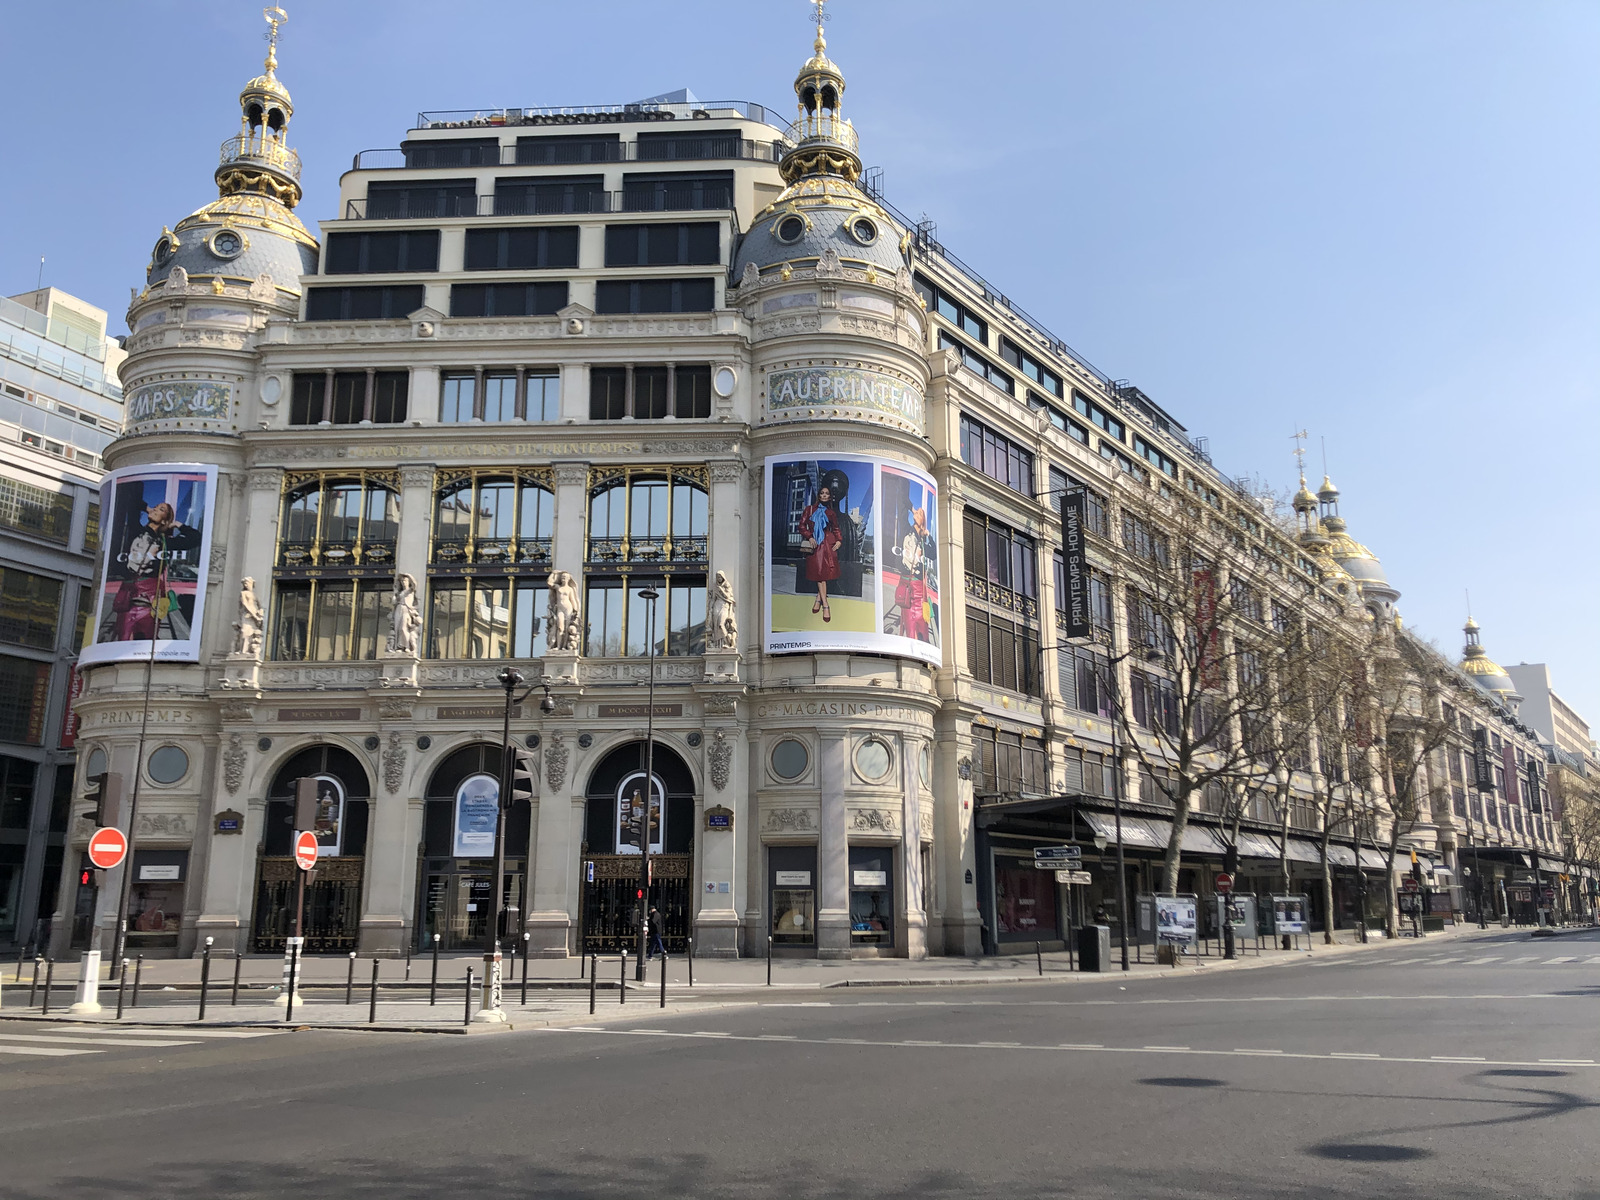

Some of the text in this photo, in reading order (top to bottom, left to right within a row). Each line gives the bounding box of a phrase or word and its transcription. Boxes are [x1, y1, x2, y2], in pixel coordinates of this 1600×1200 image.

[778, 377, 811, 402] AU
[427, 444, 509, 456] MAGASINS
[515, 443, 534, 455] DU
[543, 441, 633, 454] PRINTEMPS
[1066, 504, 1083, 626] PRINTEMPS HOMME
[769, 641, 811, 650] PRINTEMPS
[101, 710, 193, 724] PRINTEMPS
[782, 702, 867, 716] MAGASINS
[875, 705, 893, 717] DU
